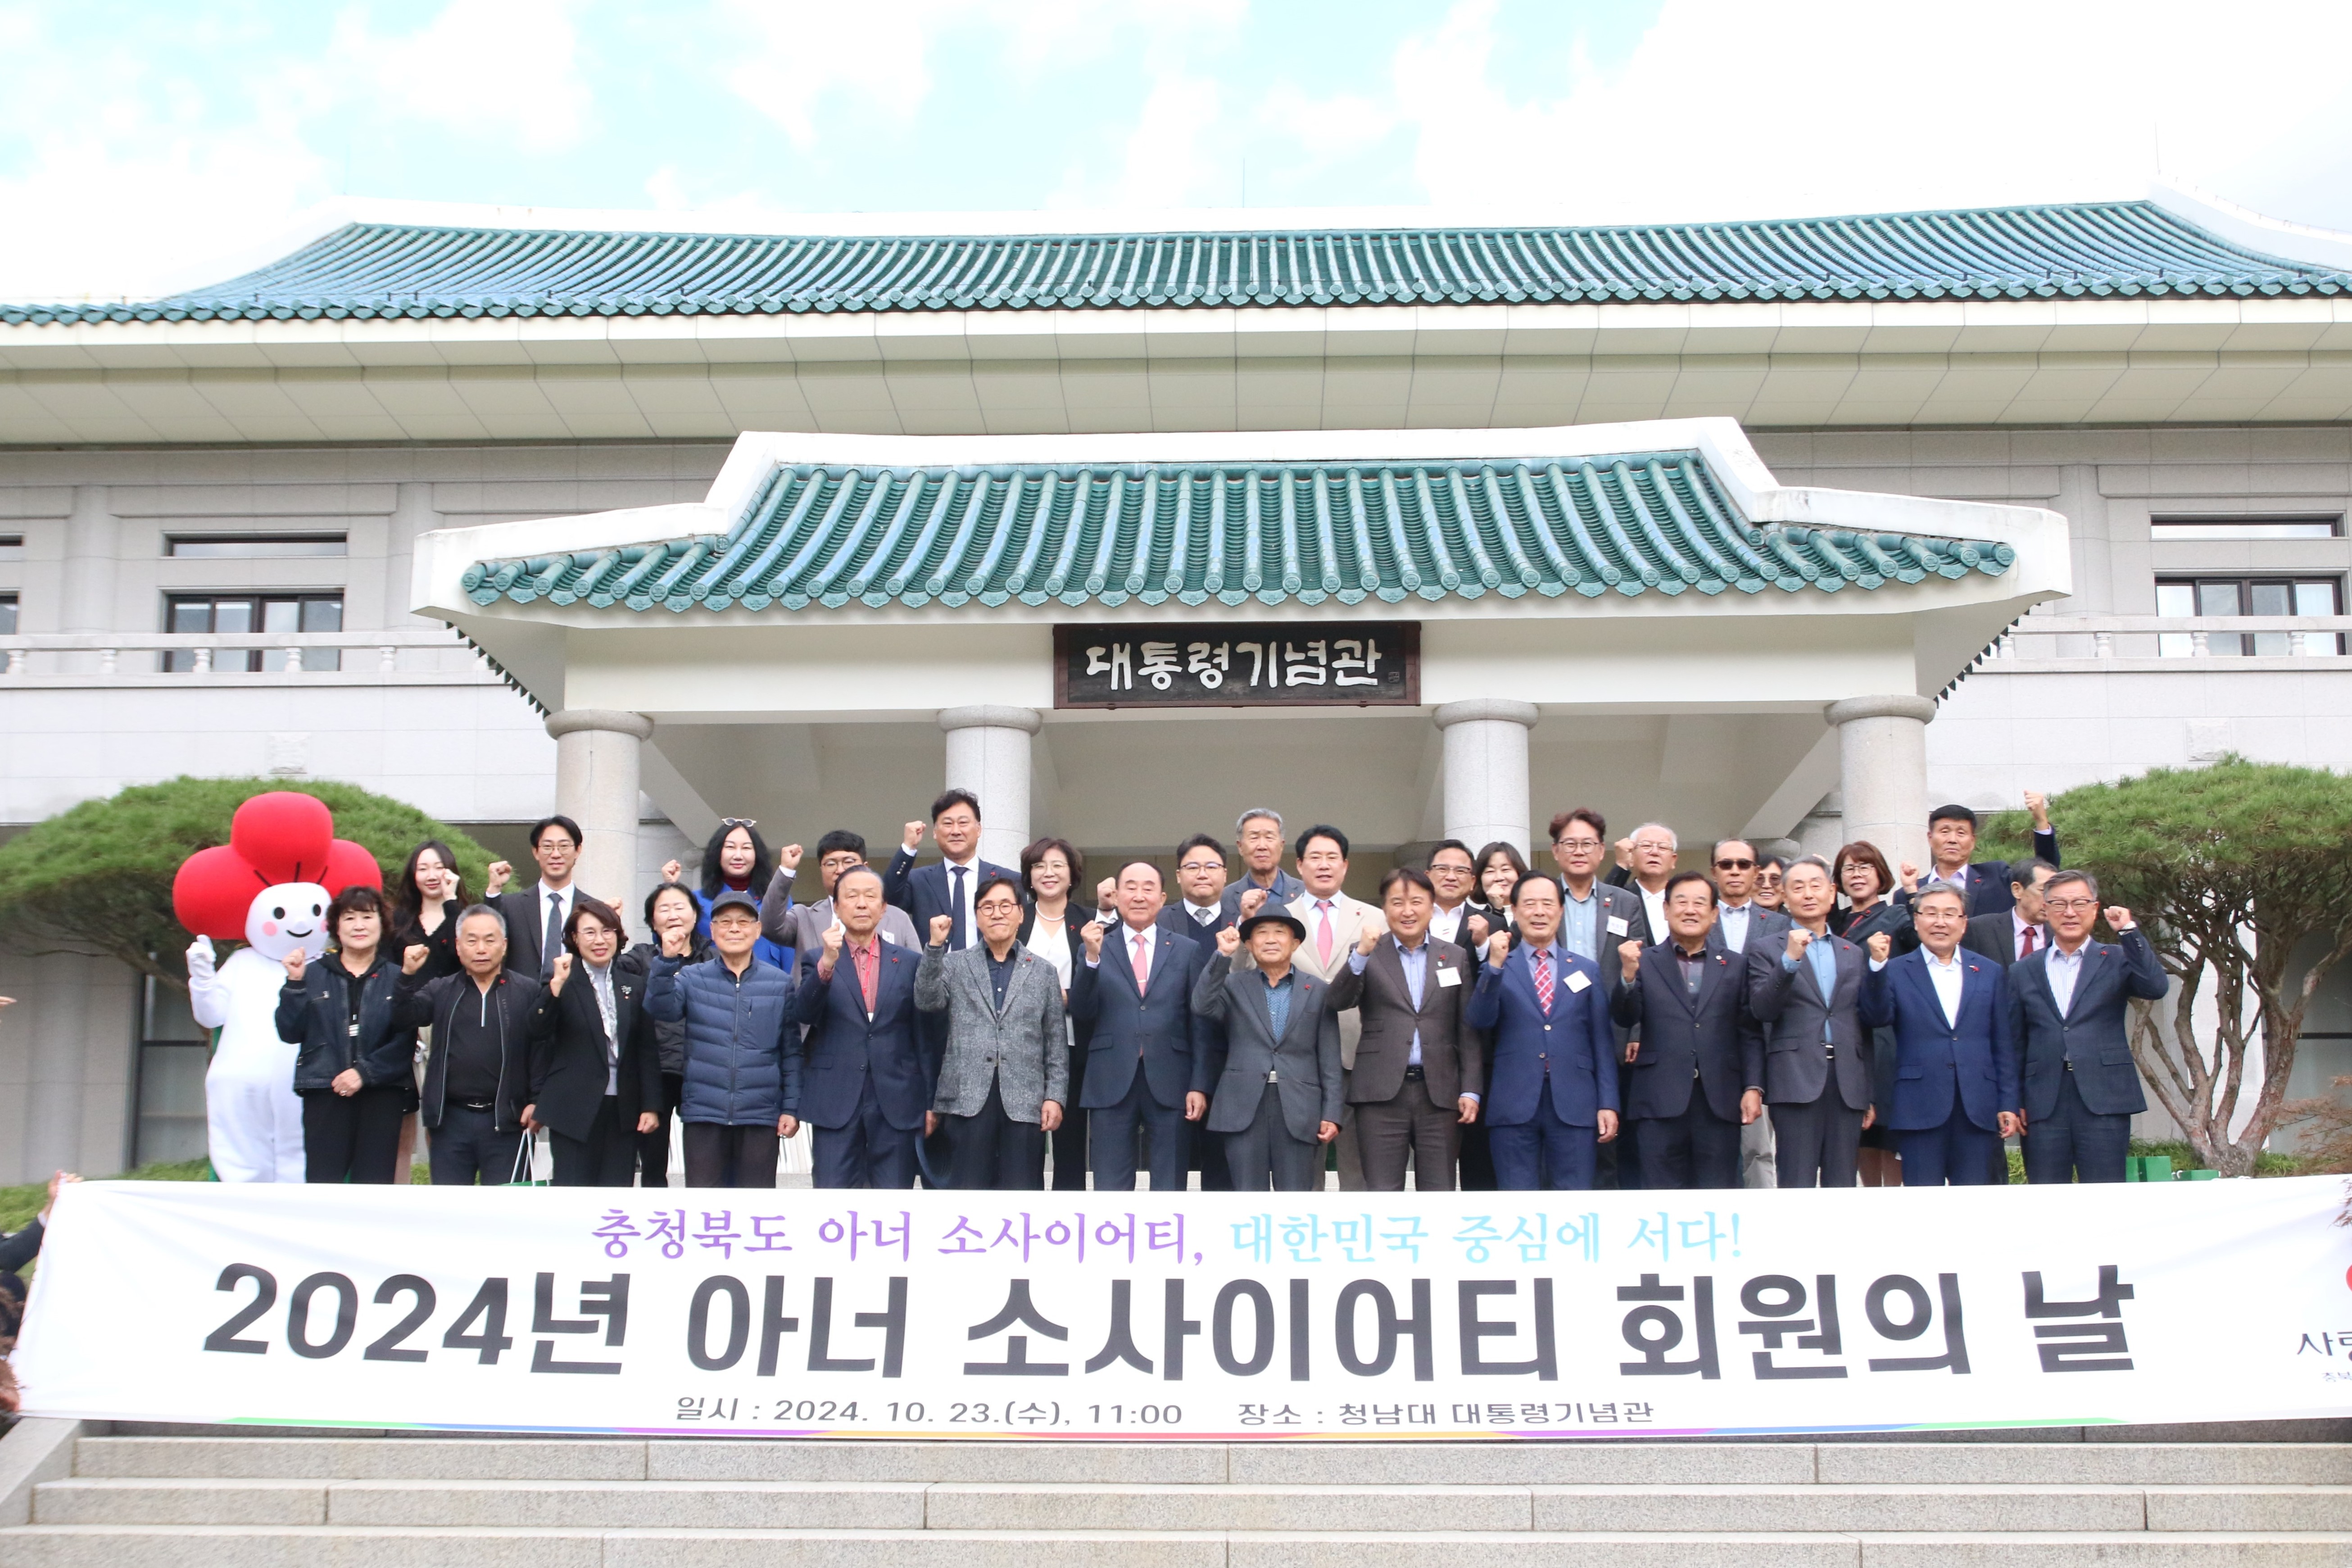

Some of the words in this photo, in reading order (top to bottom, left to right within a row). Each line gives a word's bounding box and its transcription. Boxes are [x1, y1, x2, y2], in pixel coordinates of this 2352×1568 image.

[1086, 638, 1382, 690] 대통령기념관
[592, 1209, 793, 1260] 충청북도
[819, 1210, 911, 1261] 아너
[938, 1212, 1203, 1265] 소사이어티,
[1230, 1213, 1429, 1264] 대한민국
[1452, 1212, 1600, 1264] 중심에
[1627, 1211, 1741, 1262] 서다!
[204, 1262, 631, 1375] 2024년
[687, 1274, 908, 1378] 아너
[964, 1278, 1558, 1381] 소사이어티
[1617, 1273, 1971, 1380] 회원의
[2021, 1264, 2135, 1373] 날
[677, 1397, 739, 1421] 일시
[774, 1400, 868, 1422] 2024.
[887, 1402, 934, 1422] 10.
[949, 1401, 1070, 1426] 23.(수),
[1088, 1404, 1182, 1424] 11:00
[1238, 1404, 1301, 1426] 장소
[1339, 1403, 1436, 1425] 청남대
[1452, 1402, 1654, 1424] 대통령기념관
